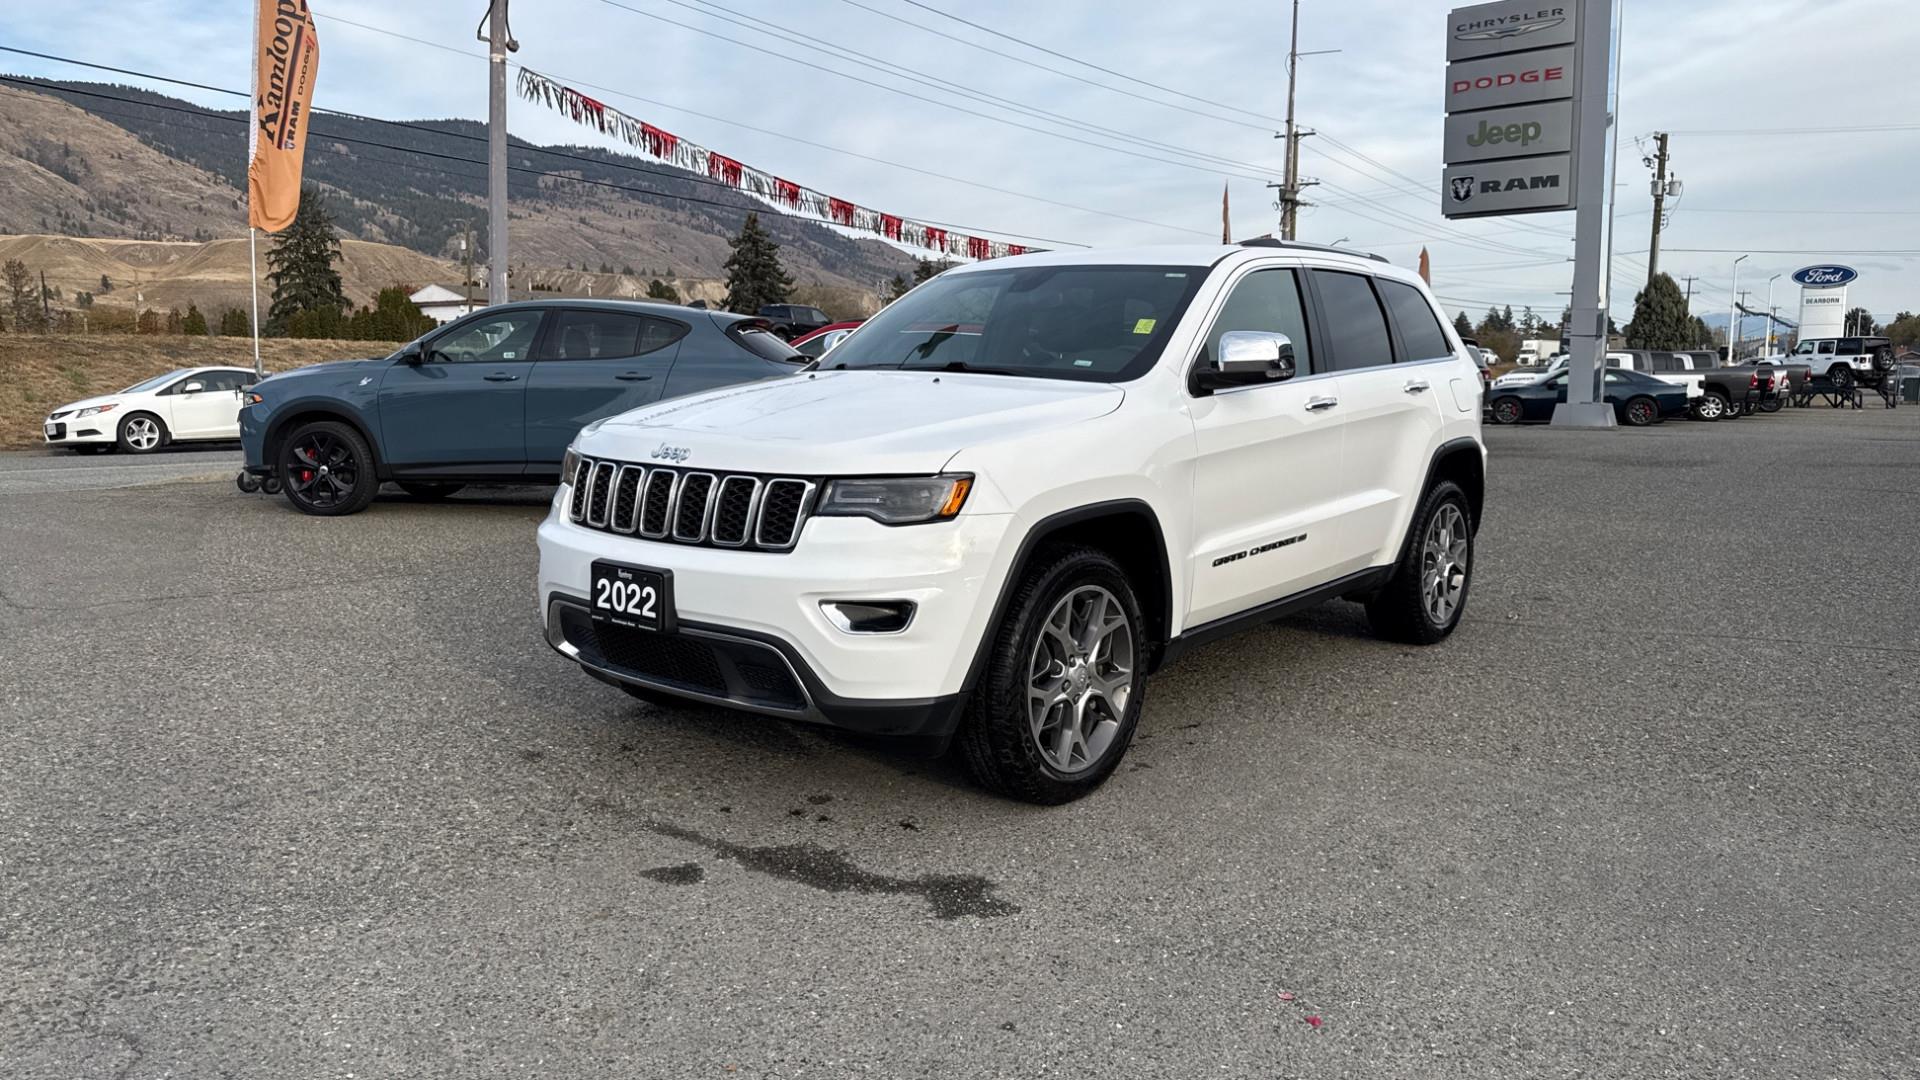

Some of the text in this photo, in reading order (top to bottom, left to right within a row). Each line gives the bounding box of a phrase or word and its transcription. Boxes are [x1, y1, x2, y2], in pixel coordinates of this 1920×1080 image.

[1455, 7, 1564, 32] CHRYSLER
[1453, 66, 1564, 94] DODGE
[287, 101, 301, 141] RAM
[1466, 120, 1542, 147] Jeep
[1480, 174, 1560, 194] RAM
[1804, 268, 1843, 283] Ford
[651, 442, 692, 464] Jeep
[1212, 550, 1248, 568] GRAND
[597, 578, 657, 619] 2022
